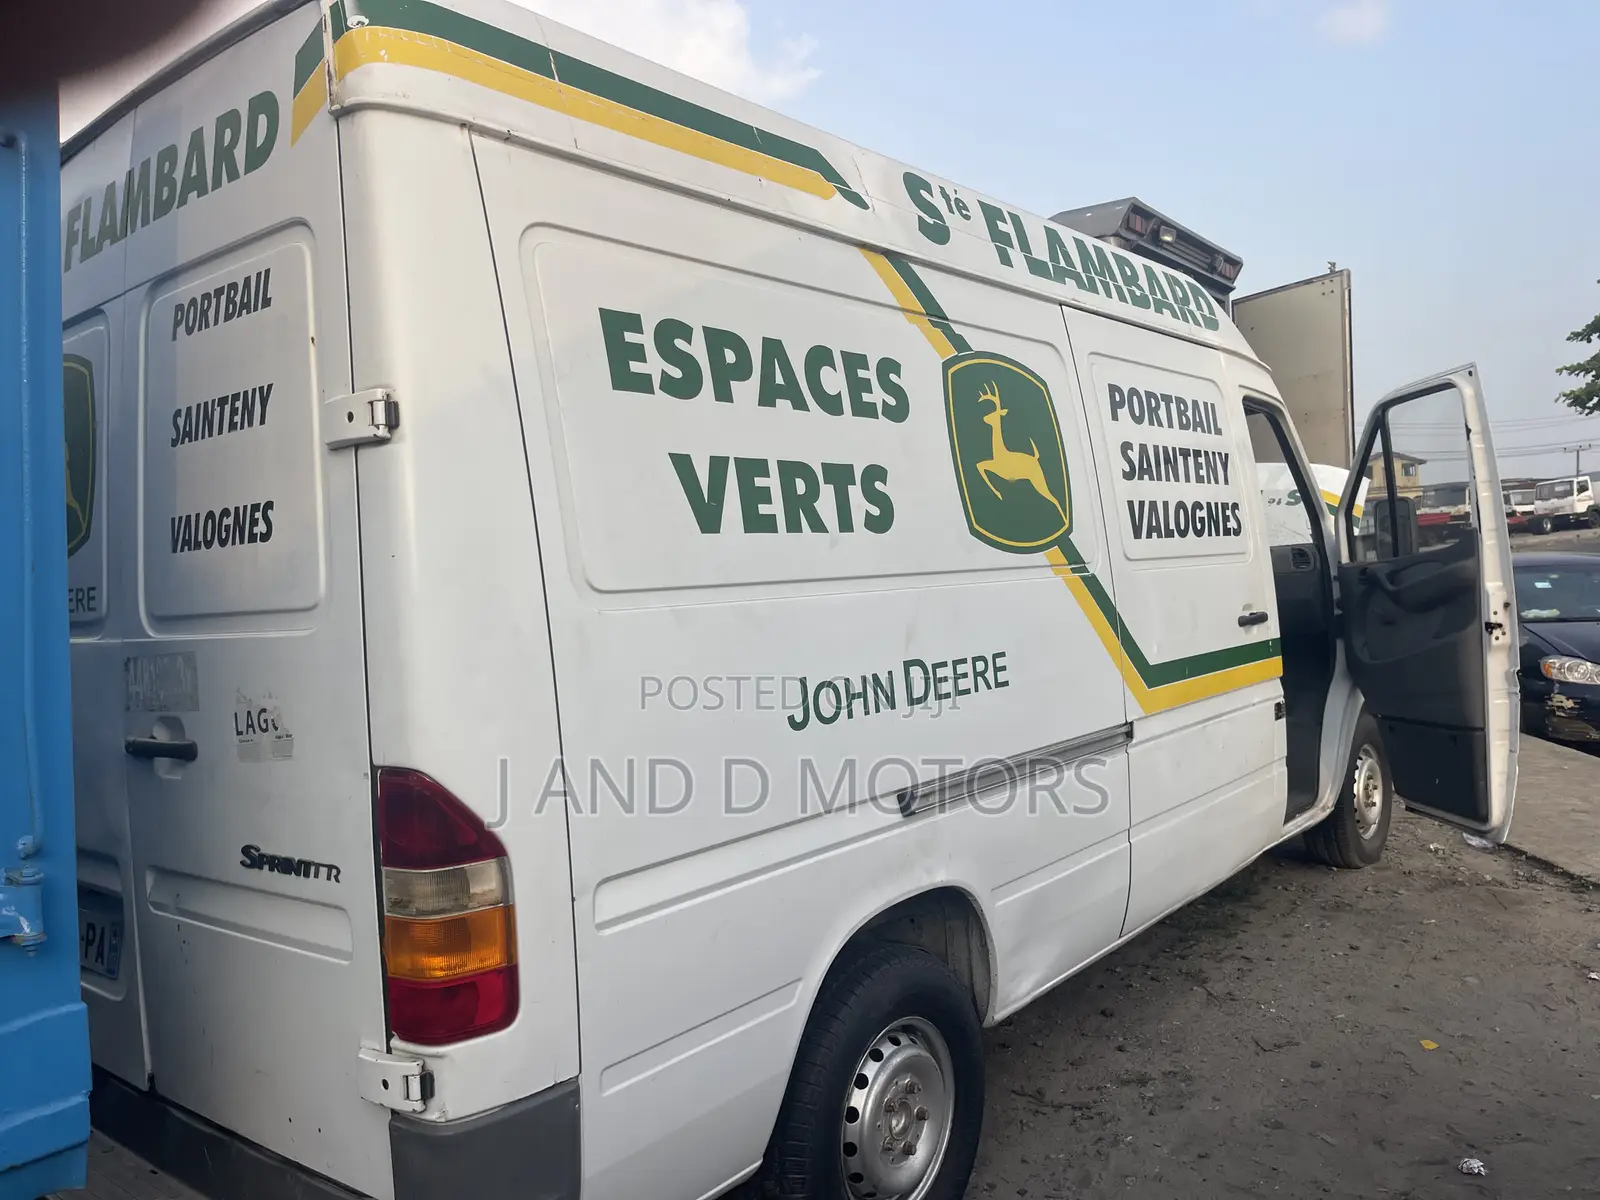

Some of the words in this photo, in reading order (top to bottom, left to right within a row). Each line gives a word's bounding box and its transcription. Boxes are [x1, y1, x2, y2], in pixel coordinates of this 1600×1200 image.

[64, 90, 280, 274] FLAMBARD
[976, 198, 1220, 332] FLAMBARD
[171, 267, 273, 342] PORTBAIL
[598, 306, 911, 424] ESPACES
[170, 383, 274, 448] SAINTENY
[1107, 382, 1223, 436] PORTBAIL
[667, 452, 895, 534] VERTS
[1120, 440, 1231, 487] SAINTENY
[170, 500, 275, 554] VALOGNES
[1127, 499, 1243, 540] VALOGNES
[787, 670, 897, 732] JOHN
[902, 651, 1010, 707] DEERE
